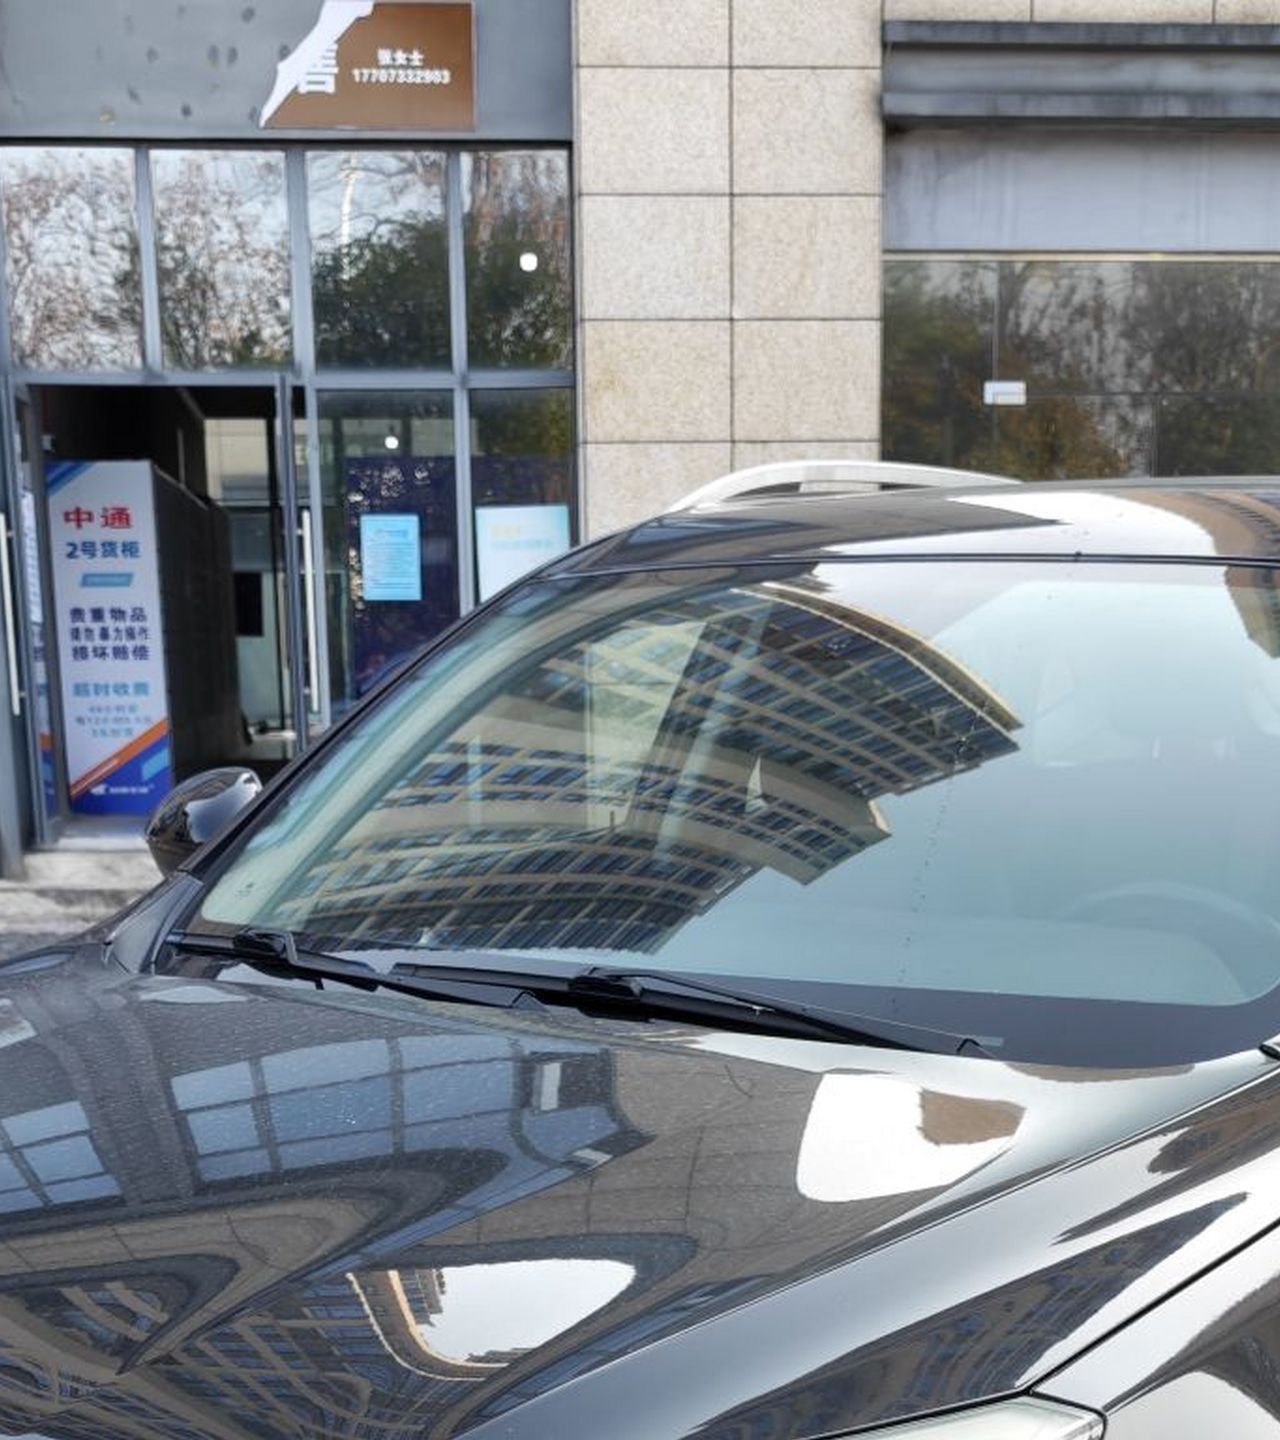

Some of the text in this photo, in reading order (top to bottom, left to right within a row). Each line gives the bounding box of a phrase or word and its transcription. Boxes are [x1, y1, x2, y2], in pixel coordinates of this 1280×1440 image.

[63, 506, 133, 530] 中通
[66, 540, 141, 560] 2号货柜
[69, 606, 148, 624] 贵重物品
